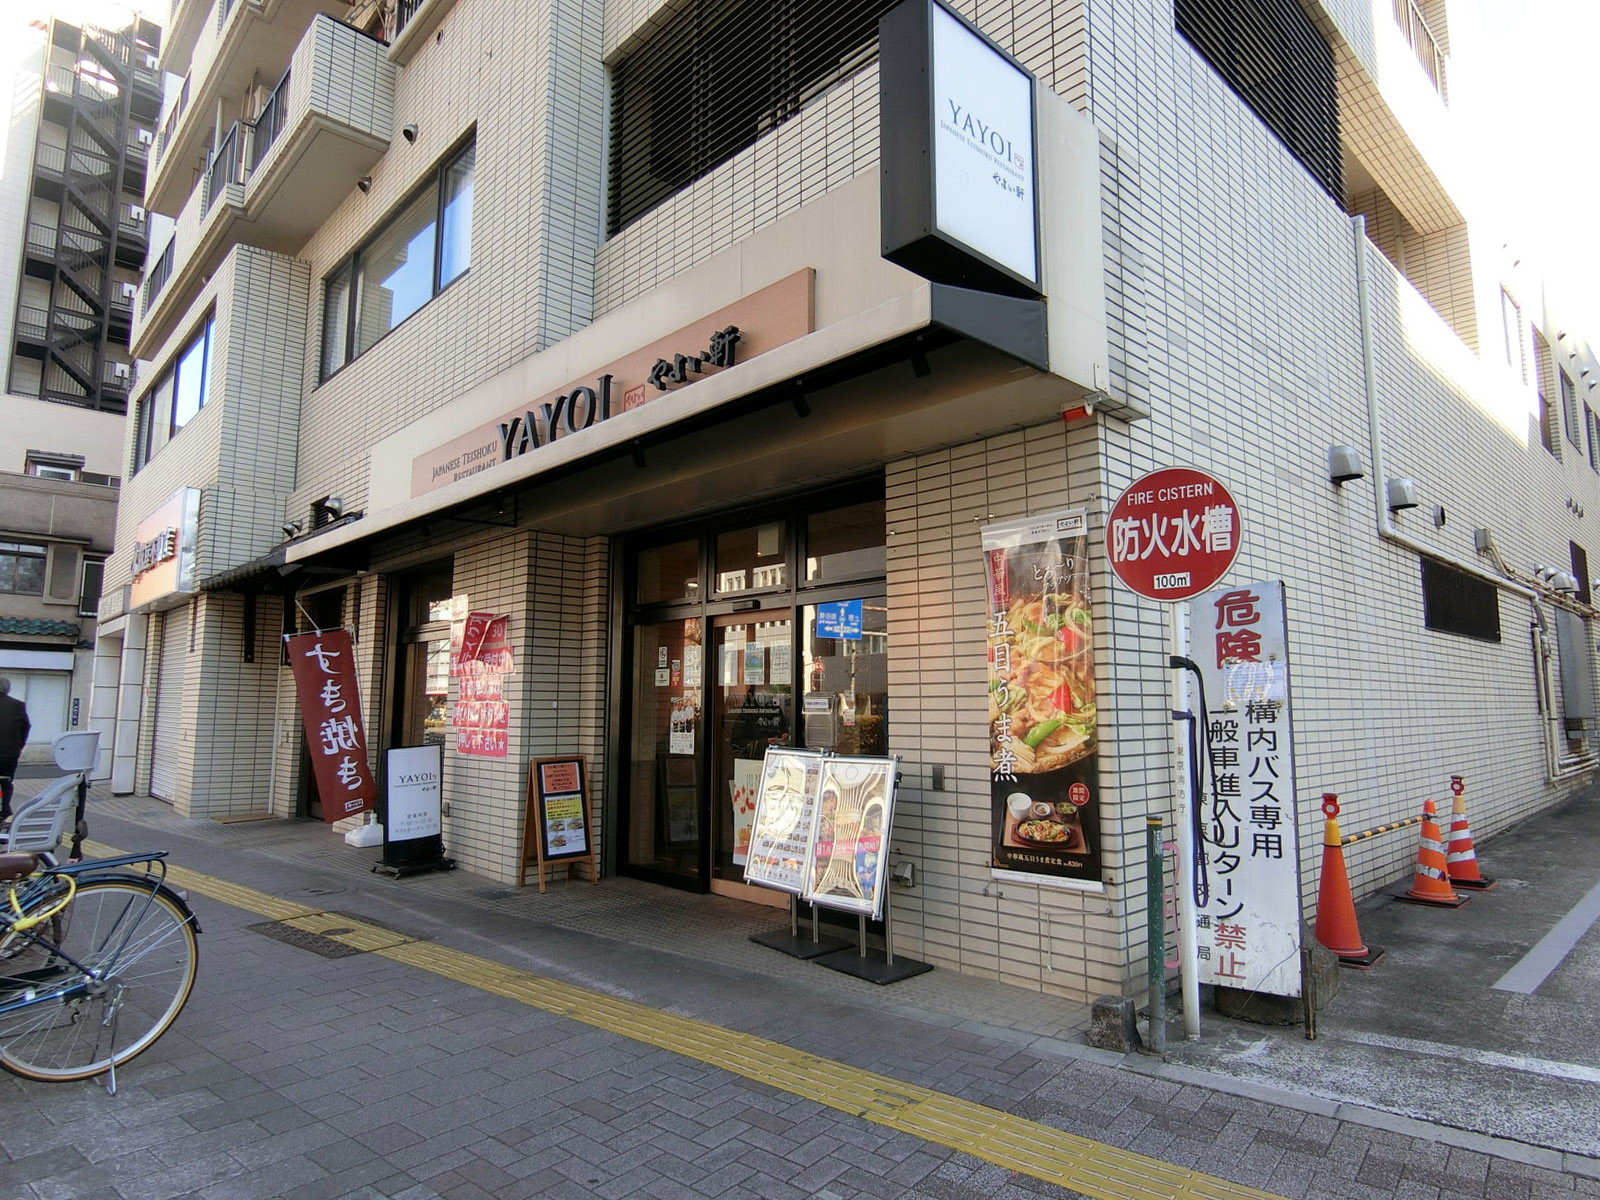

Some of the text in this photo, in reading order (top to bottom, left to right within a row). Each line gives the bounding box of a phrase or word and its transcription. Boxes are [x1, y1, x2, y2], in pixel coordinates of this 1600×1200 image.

[948, 98, 1014, 164] YAYOI
[992, 172, 1025, 202] やよい軒
[647, 325, 741, 391] やよい軒
[496, 374, 613, 462] YAYOI
[432, 440, 498, 482] JAPANESE TEISHOKU
[453, 458, 497, 482] RESTAURANT
[1127, 481, 1214, 506] FIRE CISTERN
[1112, 503, 1233, 563] 防火水槽
[1213, 589, 1263, 670] 危険
[988, 611, 1019, 784] 五目うま煮
[399, 772, 432, 784] YAYOI
[1245, 699, 1283, 860] 構内バス専用
